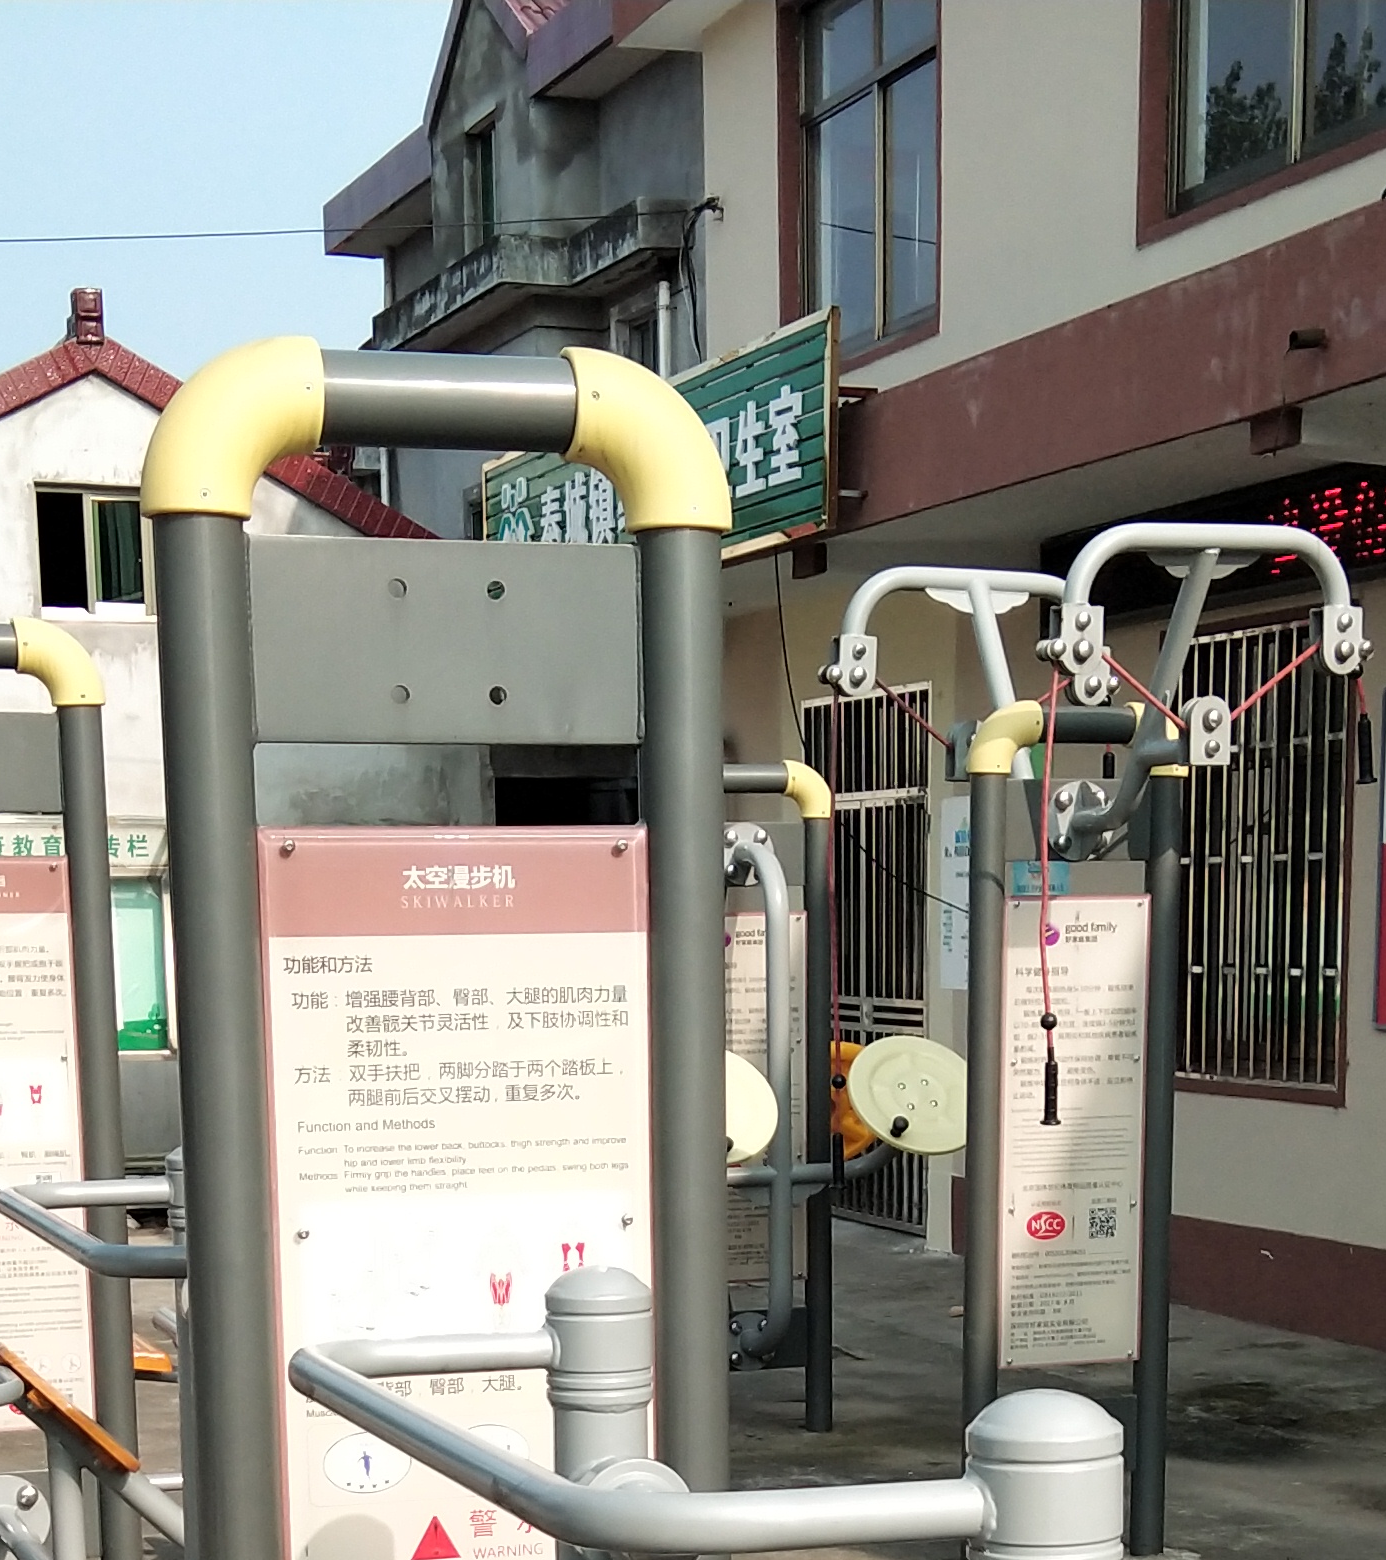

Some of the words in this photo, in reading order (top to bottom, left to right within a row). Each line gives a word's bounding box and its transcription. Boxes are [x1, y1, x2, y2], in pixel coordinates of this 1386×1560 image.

[402, 864, 516, 890] 太空漫步机
[1065, 923, 1089, 934] good
[1091, 922, 1117, 933] family
[283, 955, 373, 974] 功能和方法
[1015, 967, 1069, 976] 科学健指导
[347, 1039, 408, 1058] 柔韧性。
[297, 1121, 351, 1133] Function
[355, 1120, 378, 1131] and
[382, 1118, 436, 1130] Methods
[535, 1139, 570, 1147] strength
[592, 1137, 626, 1145] improve
[394, 1169, 408, 1177] the
[512, 1165, 525, 1173] the
[590, 1162, 608, 1170] both
[1031, 1213, 1062, 1235] NSCC
[473, 1542, 543, 1560] WARNING
